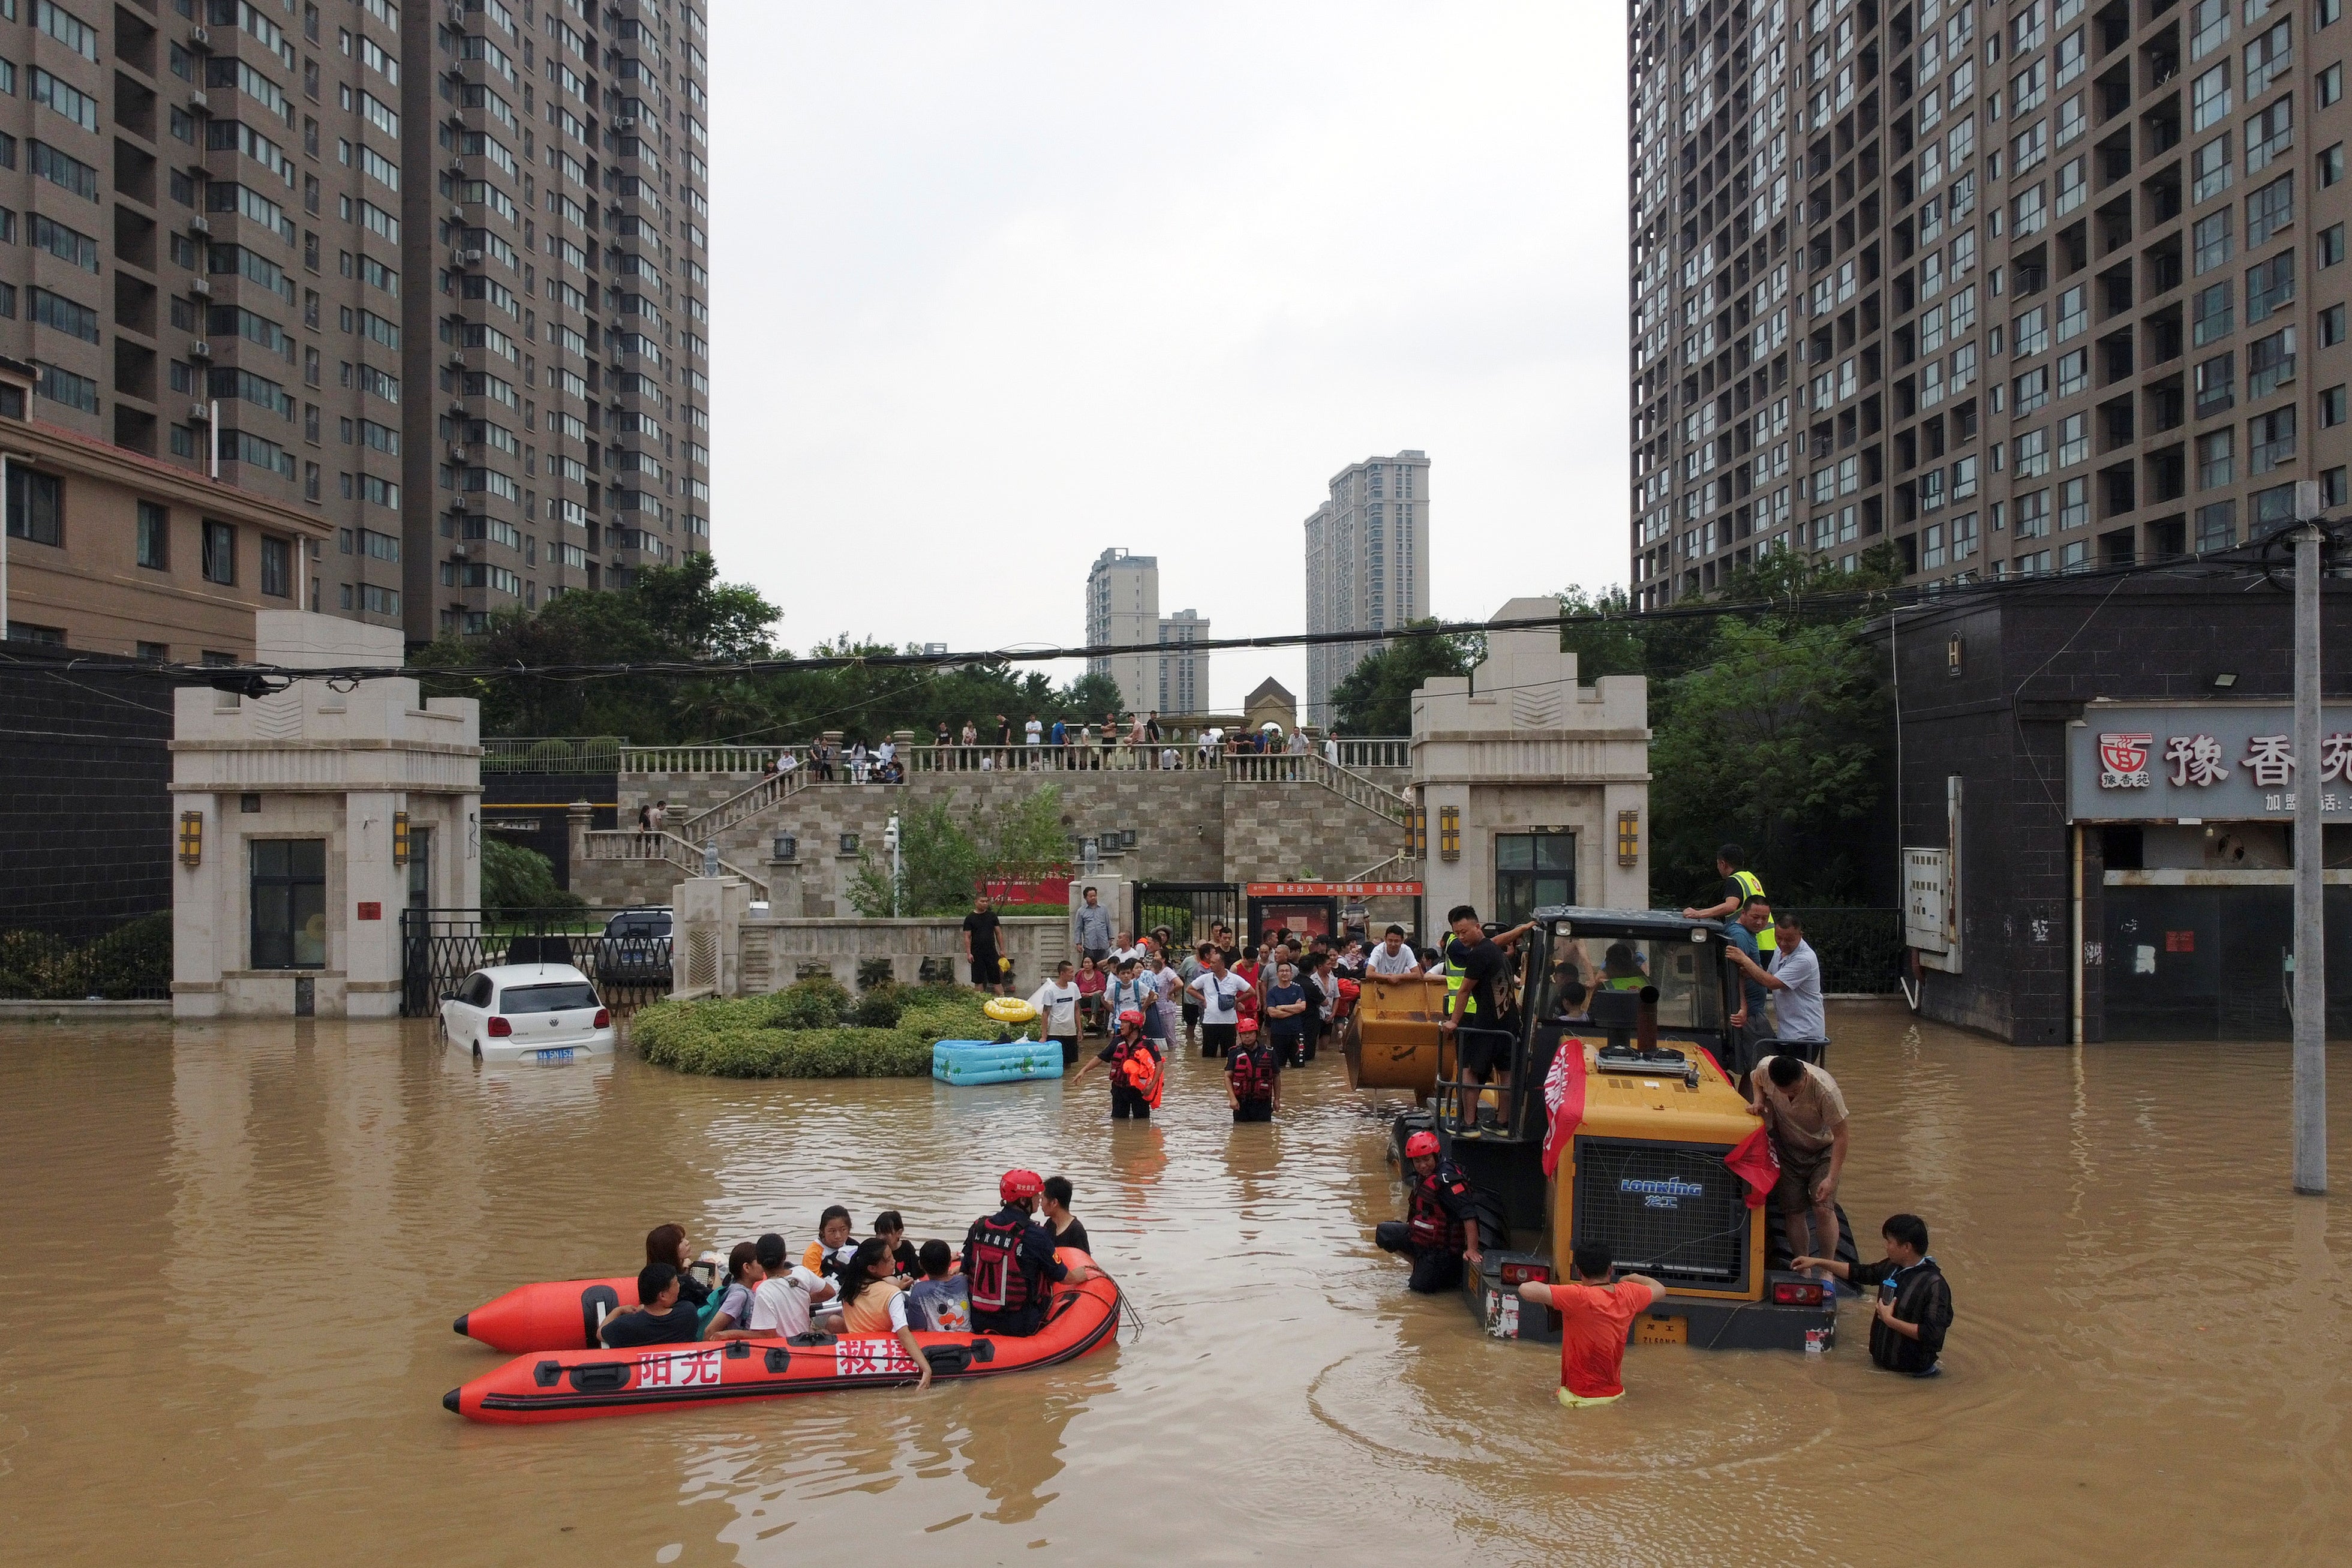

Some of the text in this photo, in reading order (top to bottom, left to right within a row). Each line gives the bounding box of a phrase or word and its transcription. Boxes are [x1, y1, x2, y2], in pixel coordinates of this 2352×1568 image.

[2104, 774, 2149, 785] 豫香苑
[2266, 794, 2342, 811] 加盟话：
[637, 1339, 918, 1386] 阳光 救援
